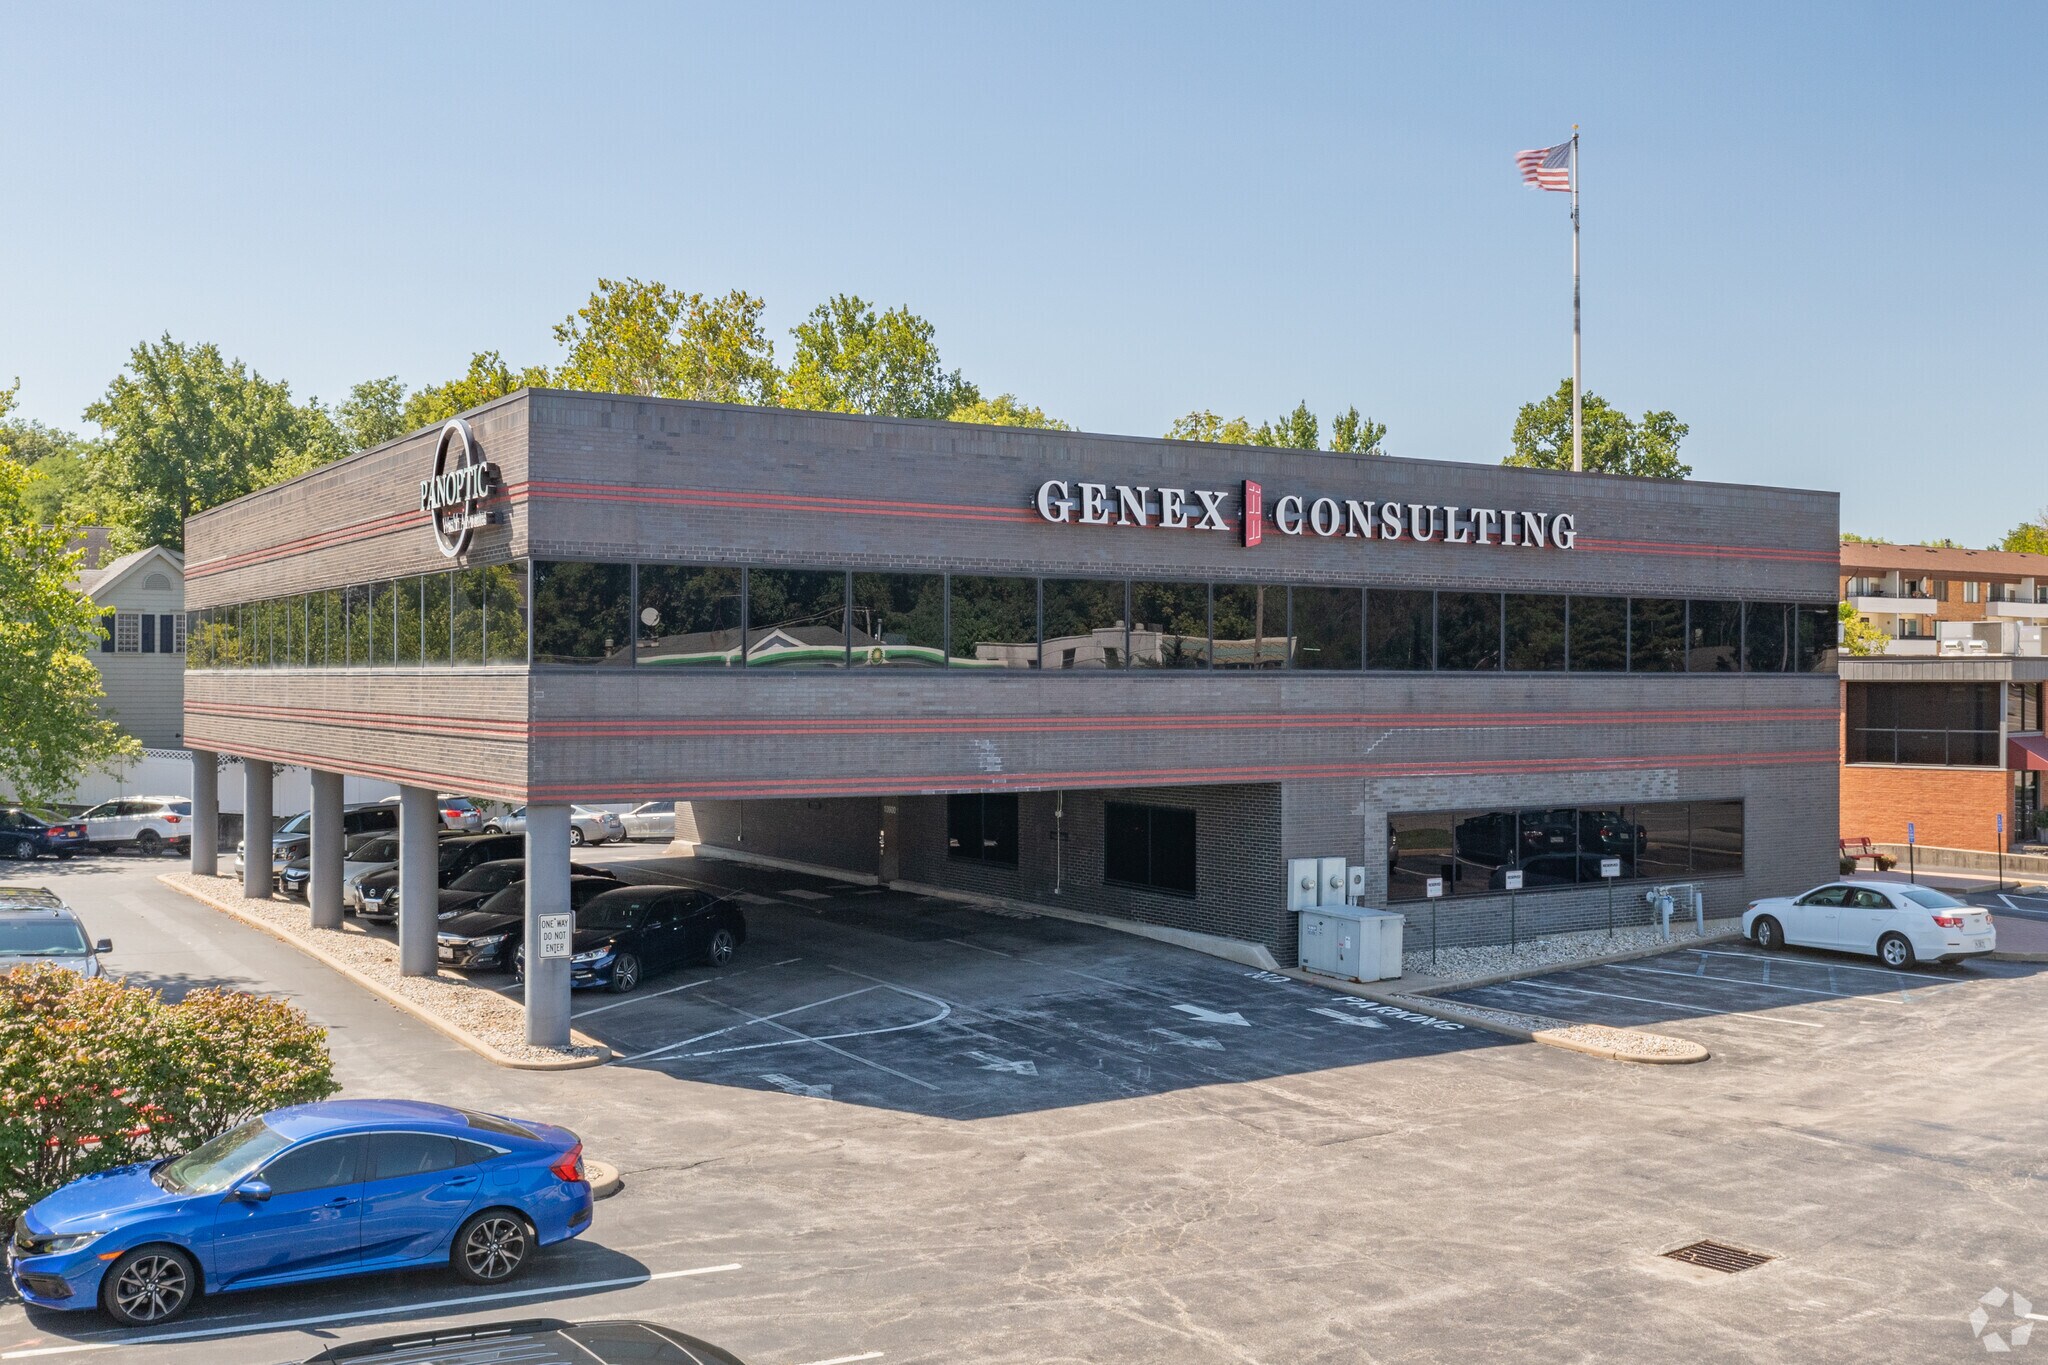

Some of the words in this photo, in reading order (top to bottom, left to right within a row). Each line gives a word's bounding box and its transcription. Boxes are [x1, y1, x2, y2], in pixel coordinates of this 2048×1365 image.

[420, 461, 489, 511] PANOPTIC
[1036, 480, 1230, 531] GENEX
[1275, 495, 1577, 550] CONSULTING
[541, 920, 554, 929] ONE
[557, 919, 568, 927] WAY
[543, 932, 552, 940] DO
[554, 931, 566, 940] NOT
[545, 943, 564, 953] ENTER
[1332, 996, 1465, 1030] PARKING
